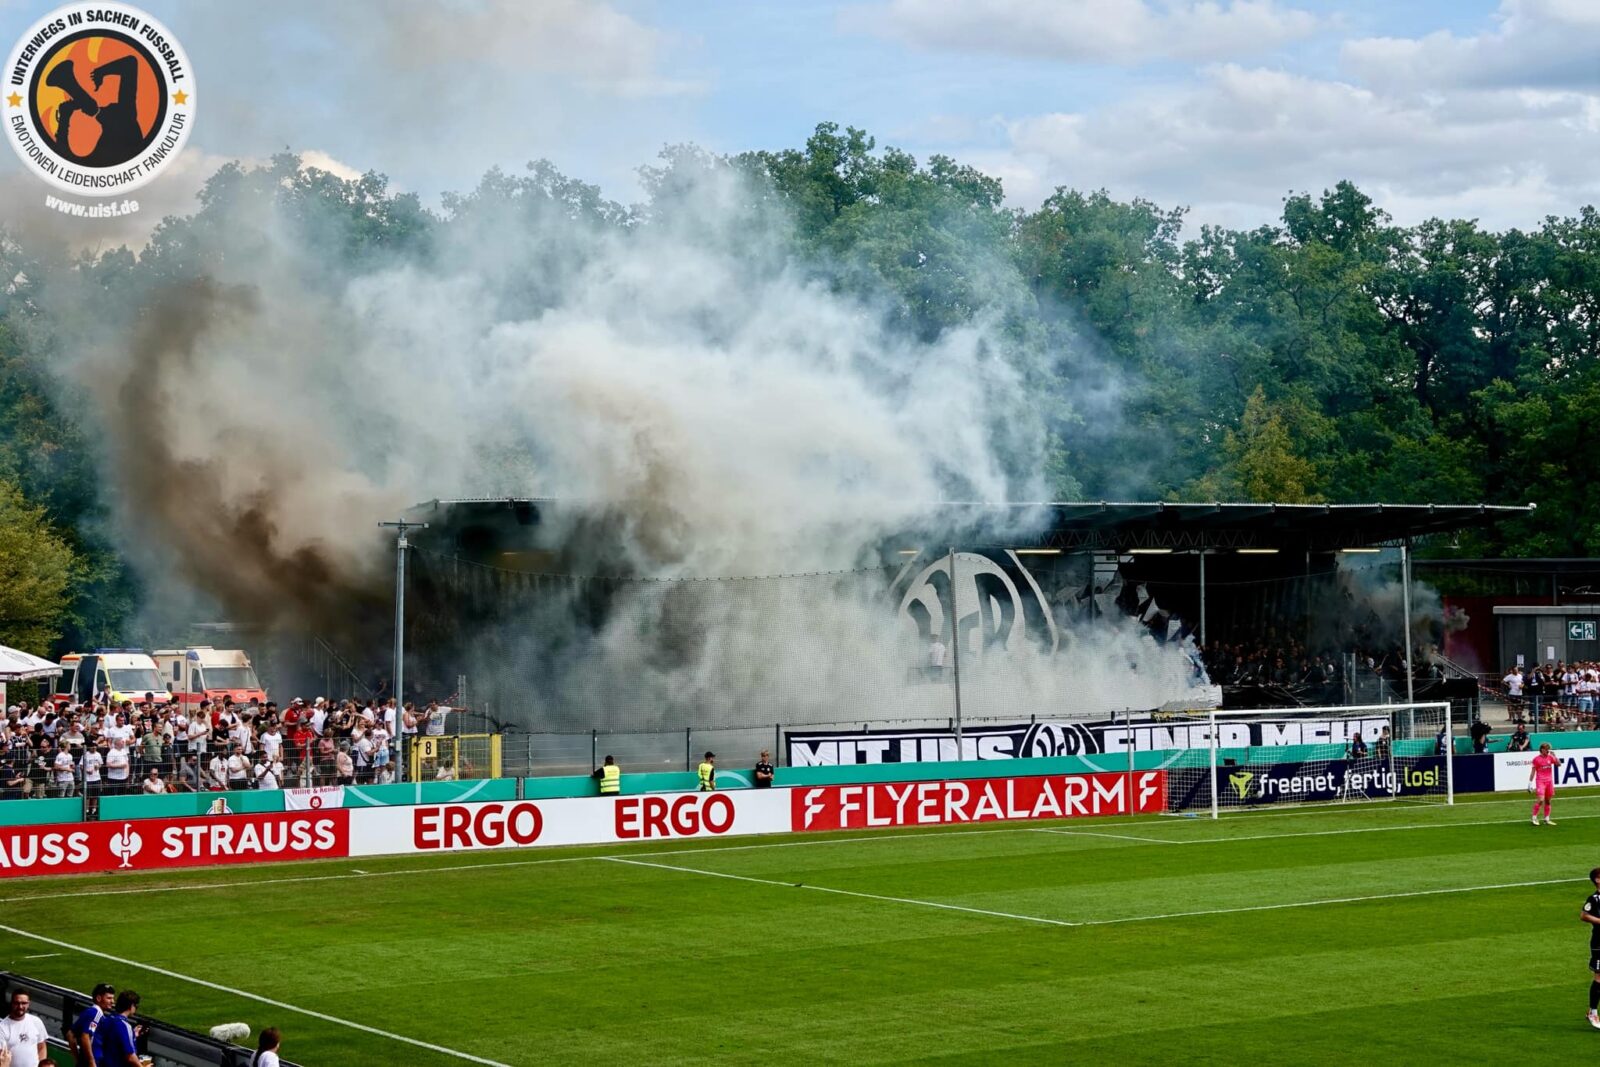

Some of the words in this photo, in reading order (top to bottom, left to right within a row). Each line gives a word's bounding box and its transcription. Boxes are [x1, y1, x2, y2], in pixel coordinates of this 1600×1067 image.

[425, 741, 432, 755] 8
[840, 774, 1125, 828] FLYERALARM
[1258, 772, 1341, 797] freenet,
[1404, 765, 1439, 787] los!
[414, 803, 543, 849] ERGO
[614, 793, 735, 839] ERGO
[161, 819, 336, 859] STRAUSS
